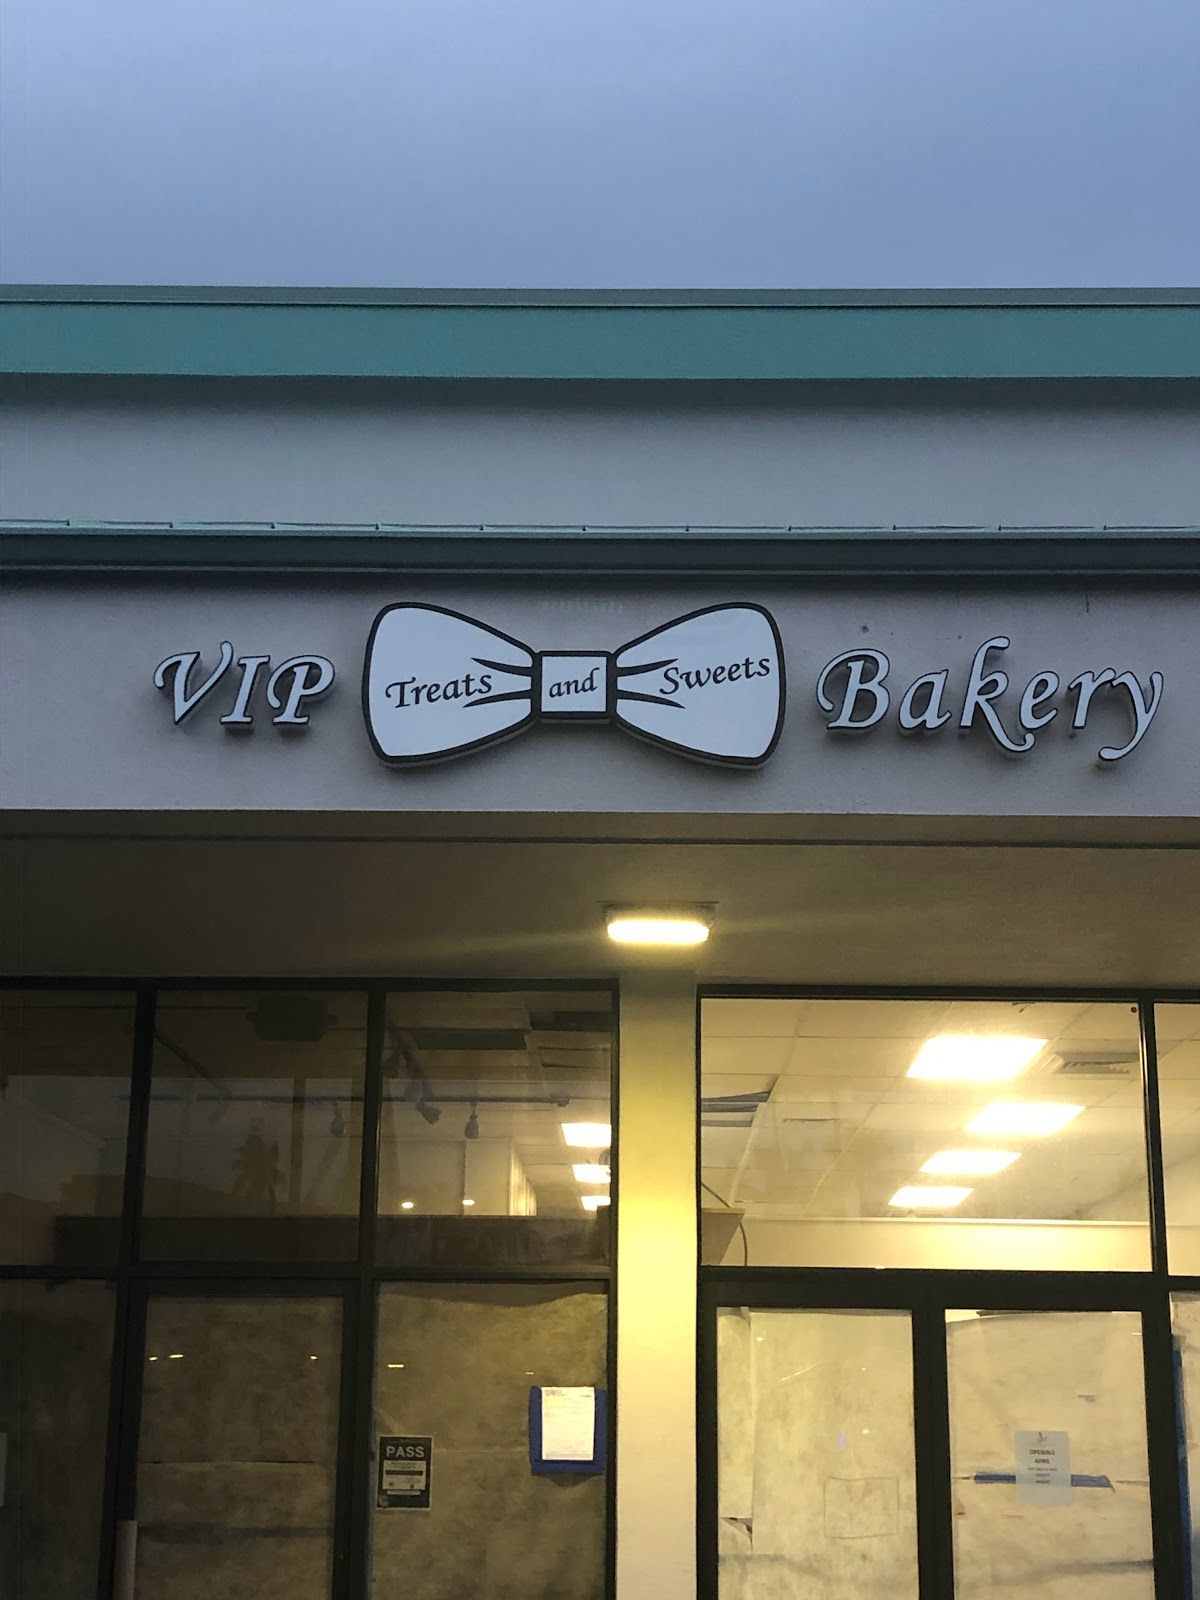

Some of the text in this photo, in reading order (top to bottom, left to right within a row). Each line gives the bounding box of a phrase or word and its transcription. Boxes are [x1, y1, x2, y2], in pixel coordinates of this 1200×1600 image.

[153, 641, 335, 726] VIP
[385, 657, 770, 709] Treats and Sweets
[816, 635, 1164, 761] Bakery
[386, 1446, 425, 1458] PASS
